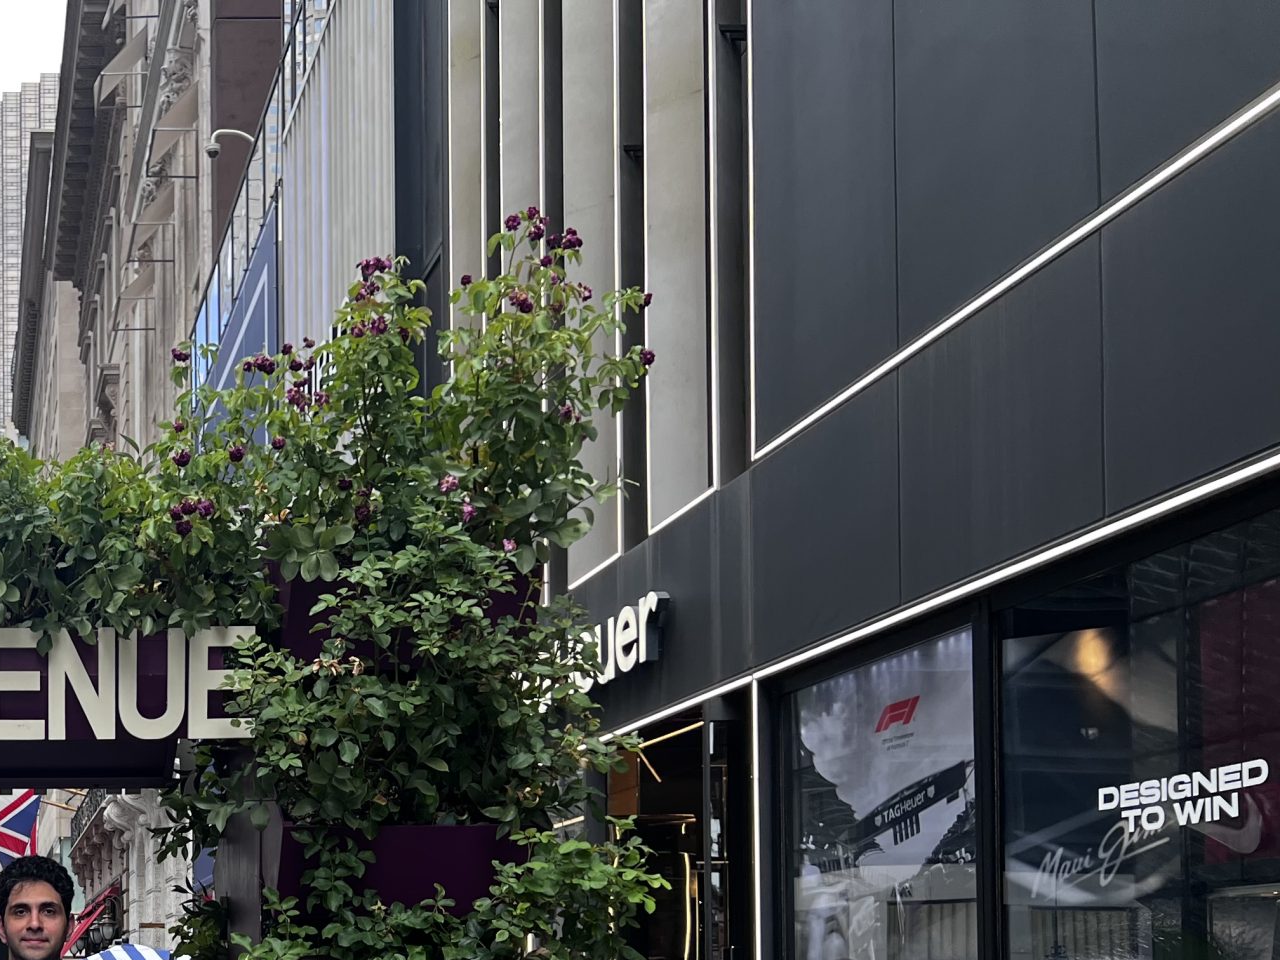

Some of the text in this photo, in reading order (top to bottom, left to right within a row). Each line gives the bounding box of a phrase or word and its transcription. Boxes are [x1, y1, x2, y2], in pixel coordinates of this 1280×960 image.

[1098, 758, 1269, 811] DESIGNED
[1121, 792, 1240, 833] TO WIN
[1031, 846, 1093, 899] Maui
